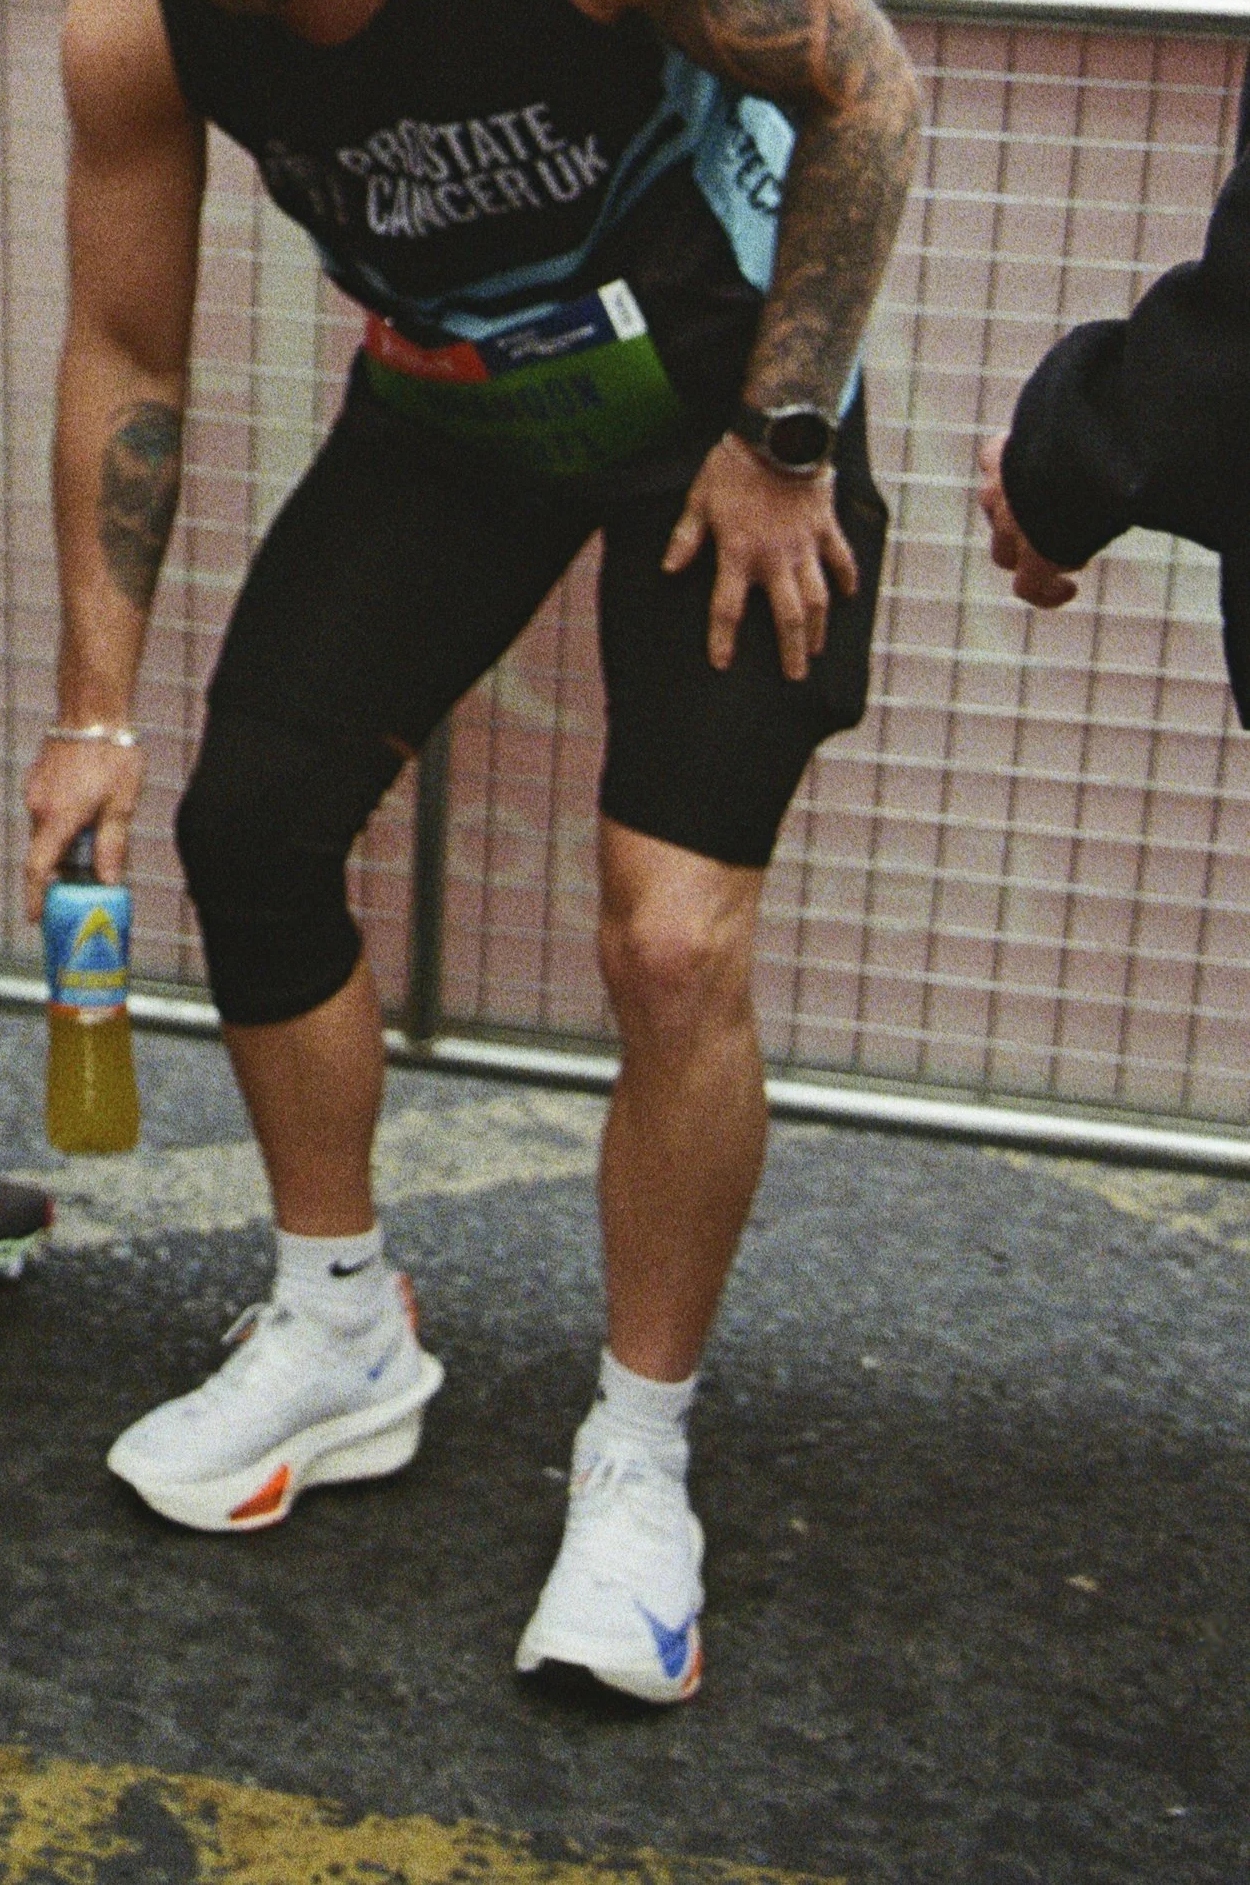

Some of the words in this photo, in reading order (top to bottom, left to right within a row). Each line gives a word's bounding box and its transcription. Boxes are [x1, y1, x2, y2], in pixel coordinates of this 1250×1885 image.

[337, 101, 568, 182] PROSTATE
[365, 168, 543, 239] CANCER
[535, 133, 610, 204] UK
